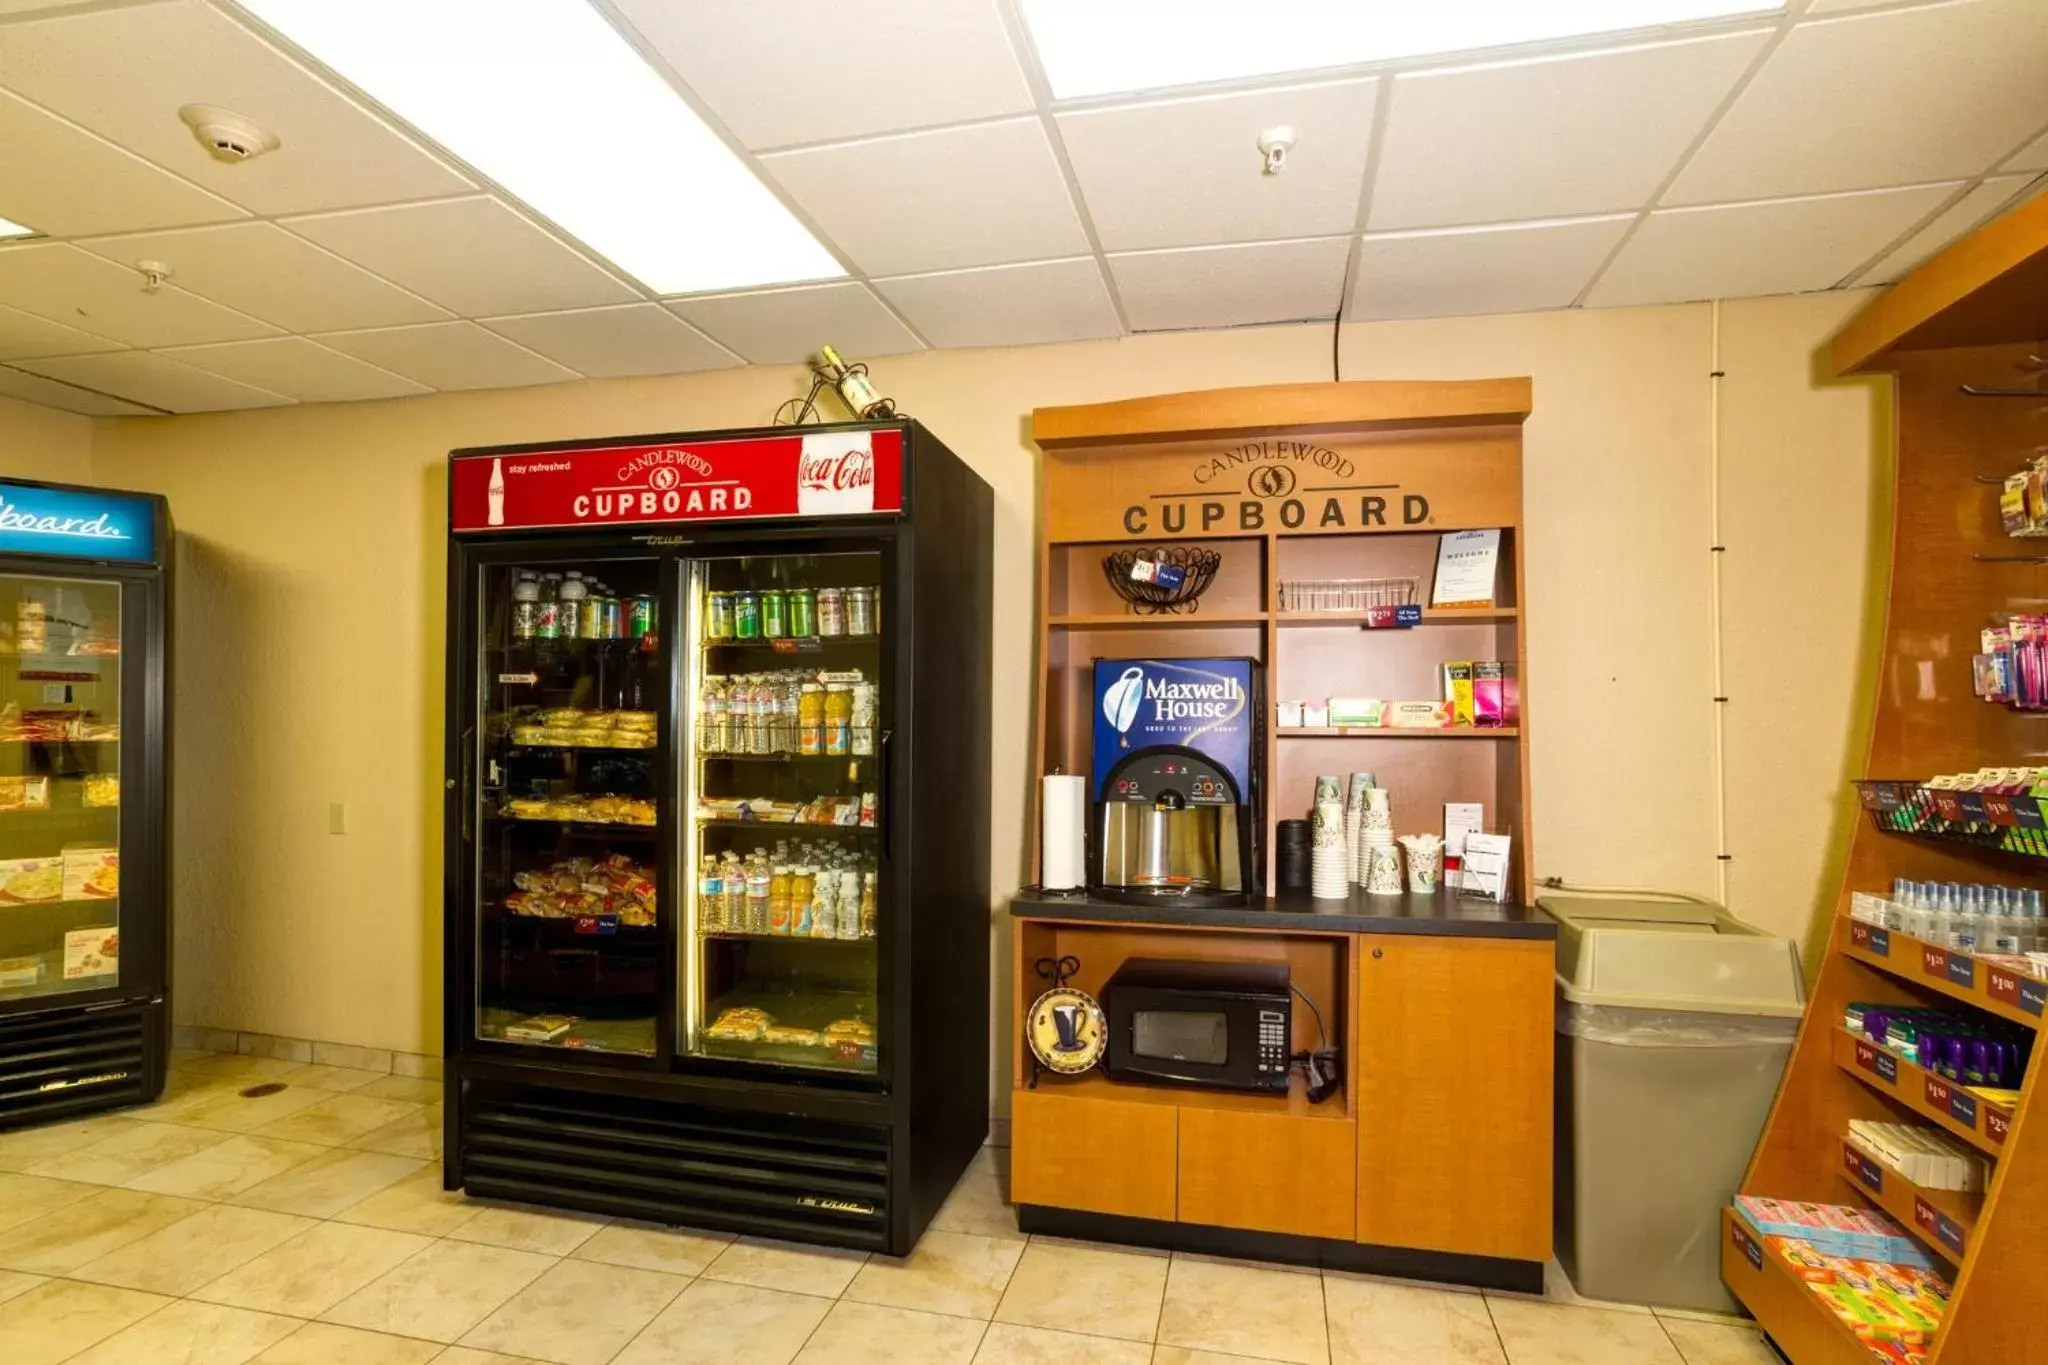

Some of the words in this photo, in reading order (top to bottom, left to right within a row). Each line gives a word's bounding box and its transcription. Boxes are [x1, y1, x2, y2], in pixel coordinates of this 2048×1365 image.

[509, 464, 526, 474] stay
[528, 461, 571, 473] refreshed
[617, 449, 713, 481] CANDLEWOOD
[800, 450, 872, 491] Coca-Cola
[1193, 441, 1356, 484] CANDLEWOOD
[573, 487, 751, 518] CUPBOARD
[1123, 495, 1430, 534] CUPBOARD
[1144, 677, 1238, 700] Maxwell
[1155, 701, 1227, 720] House
